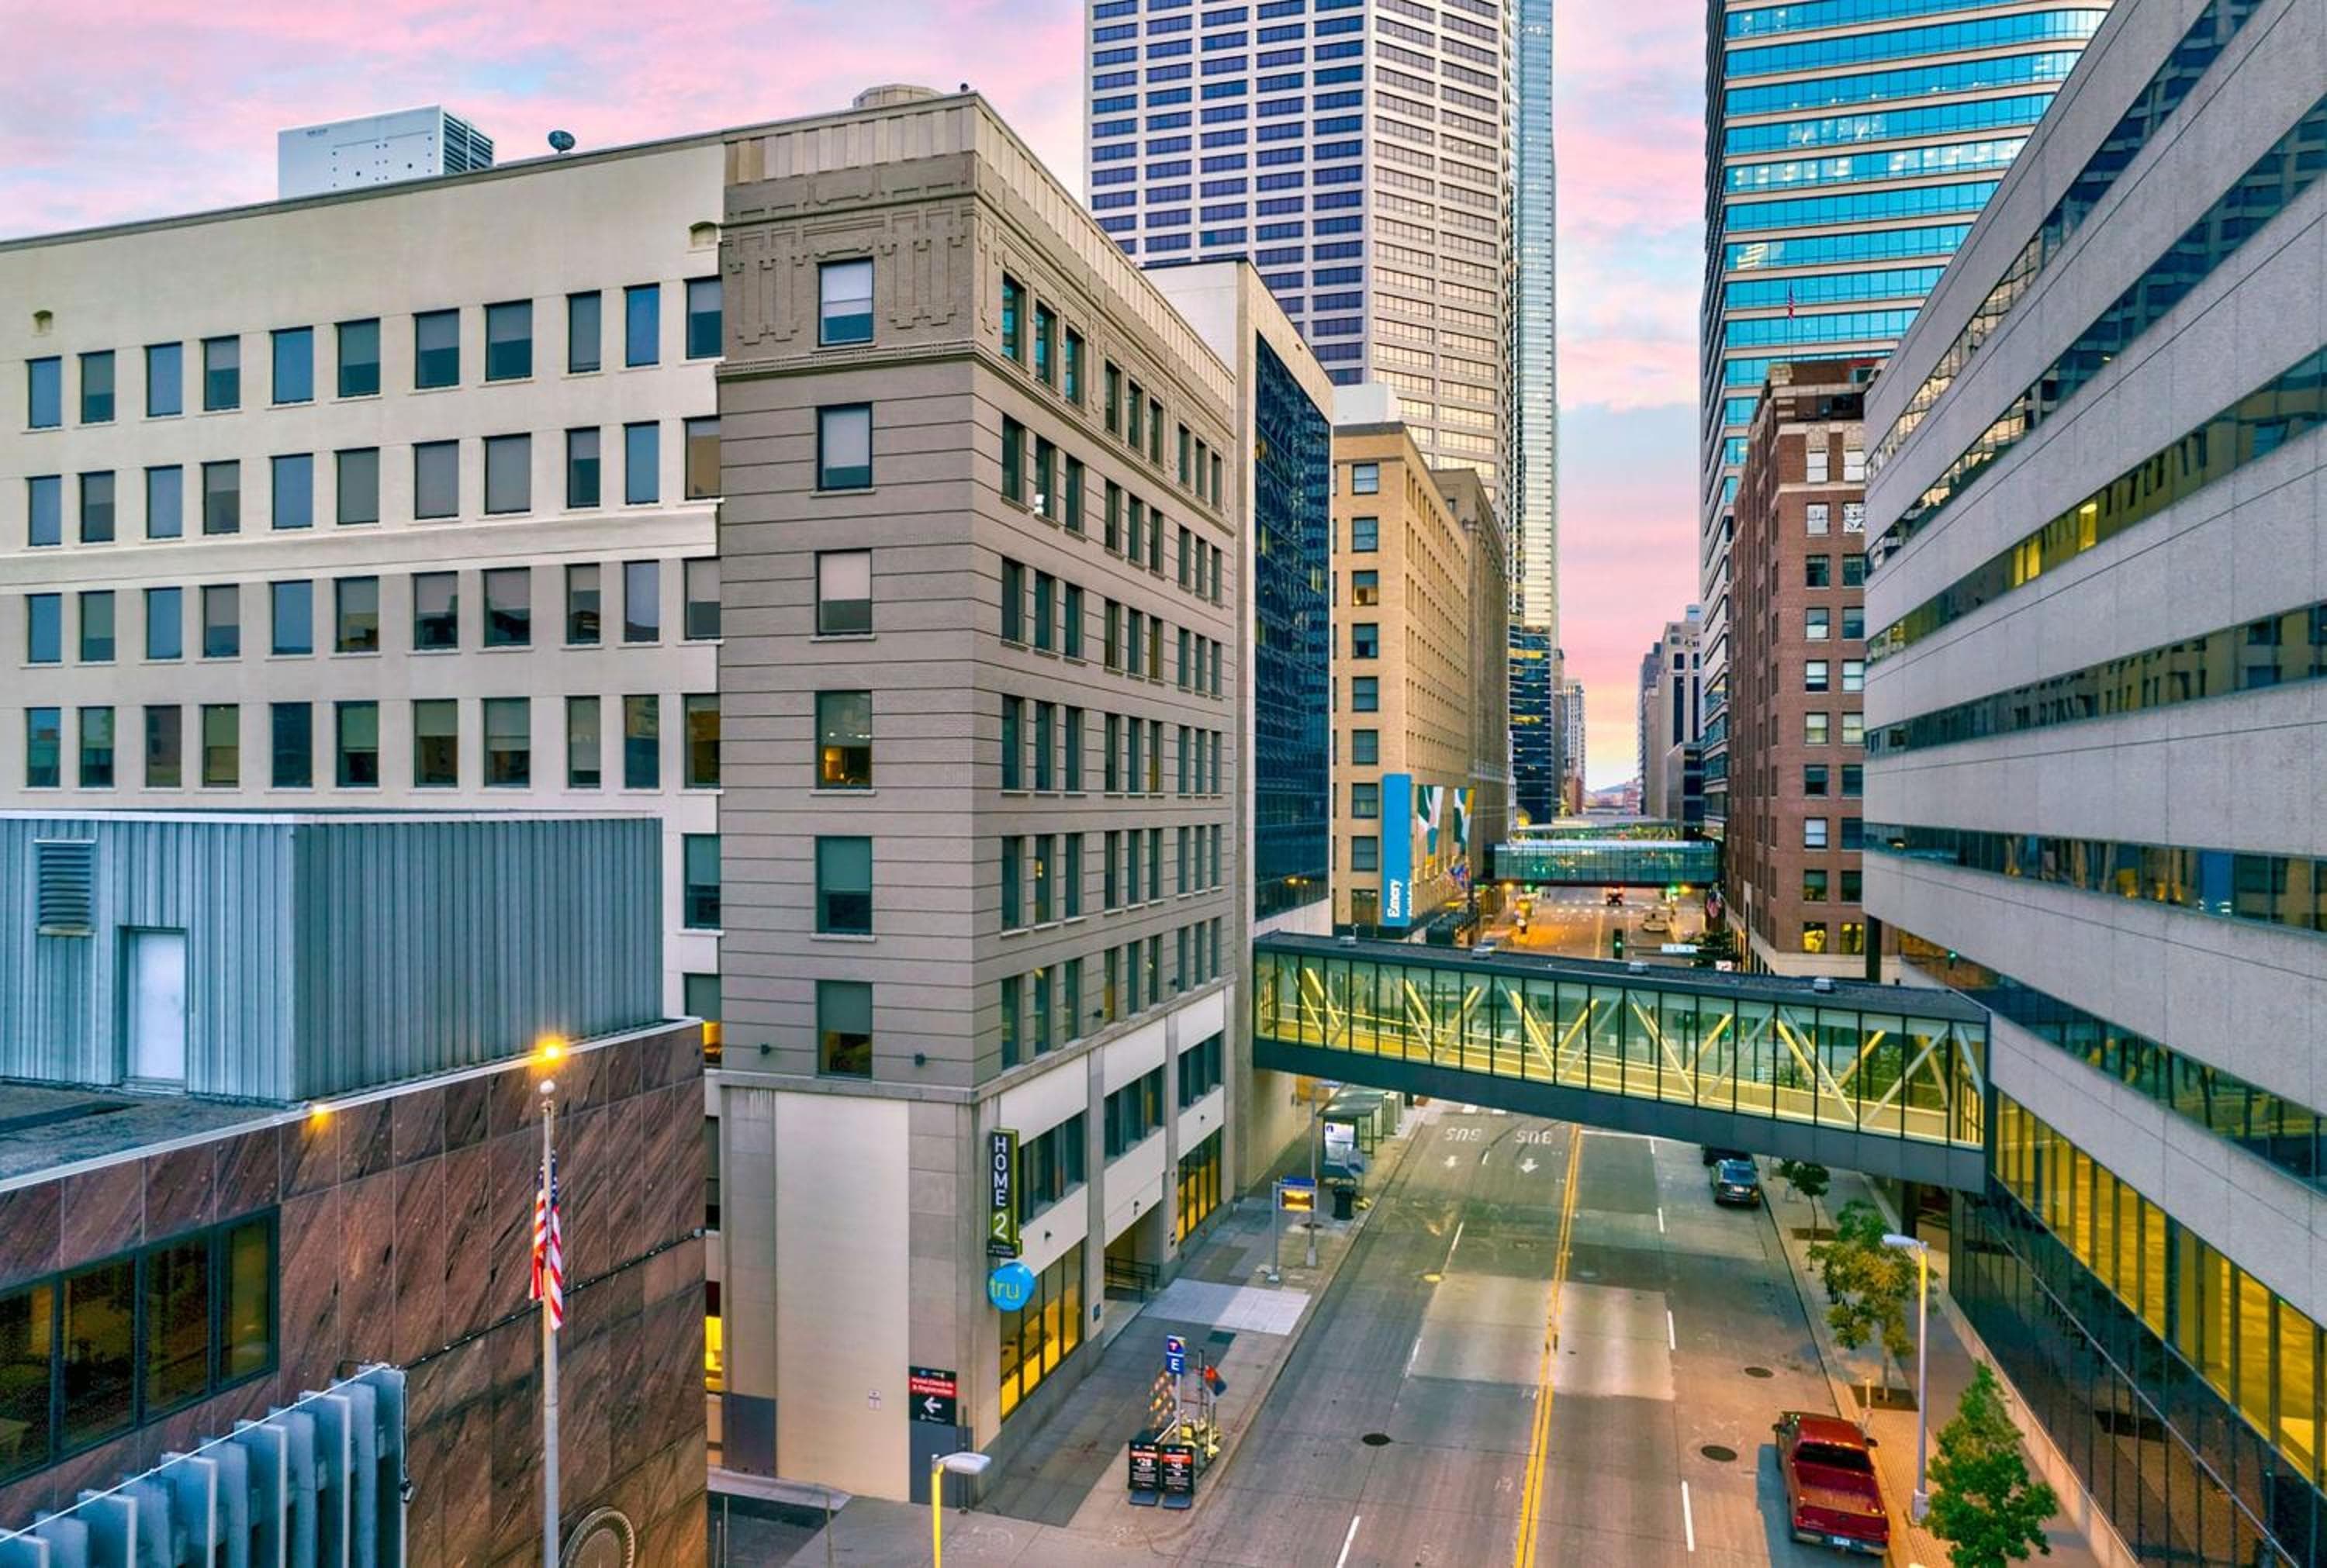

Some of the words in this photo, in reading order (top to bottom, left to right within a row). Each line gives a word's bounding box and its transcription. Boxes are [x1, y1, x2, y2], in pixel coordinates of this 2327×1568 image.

[1444, 1127, 1482, 1142] BUS
[1515, 1129, 1552, 1144] BUS
[994, 1135, 1008, 1207] HOME
[993, 1211, 1008, 1239] 2
[988, 1276, 1020, 1300] tru
[1171, 1358, 1180, 1370] E
